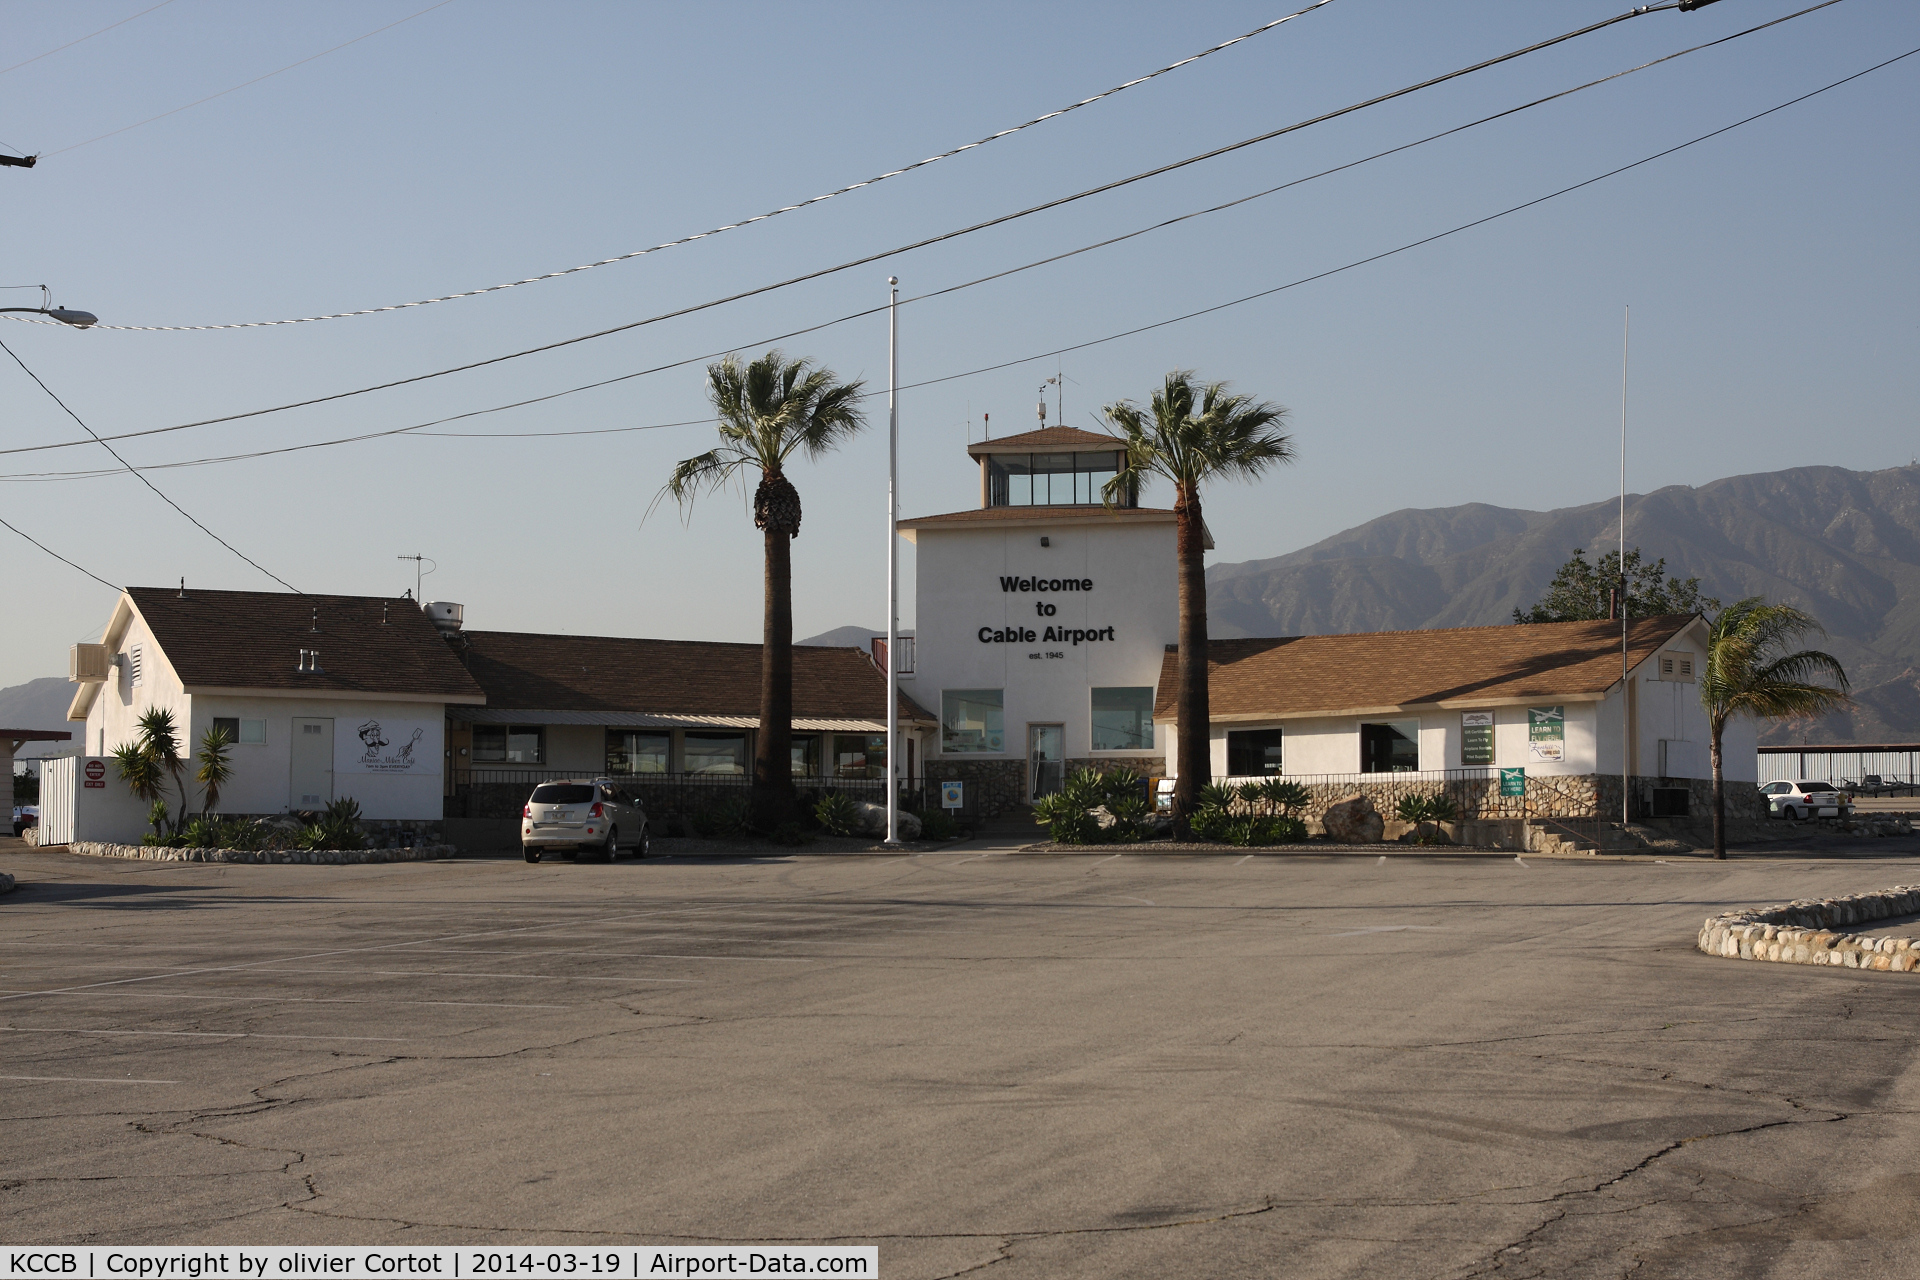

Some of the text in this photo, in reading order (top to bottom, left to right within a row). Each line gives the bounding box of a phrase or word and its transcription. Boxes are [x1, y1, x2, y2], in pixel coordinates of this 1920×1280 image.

[1000, 576, 1093, 592] Welcome
[1036, 601, 1056, 617] to
[978, 626, 1115, 646] Cable Airport
[1029, 652, 1043, 660] est.
